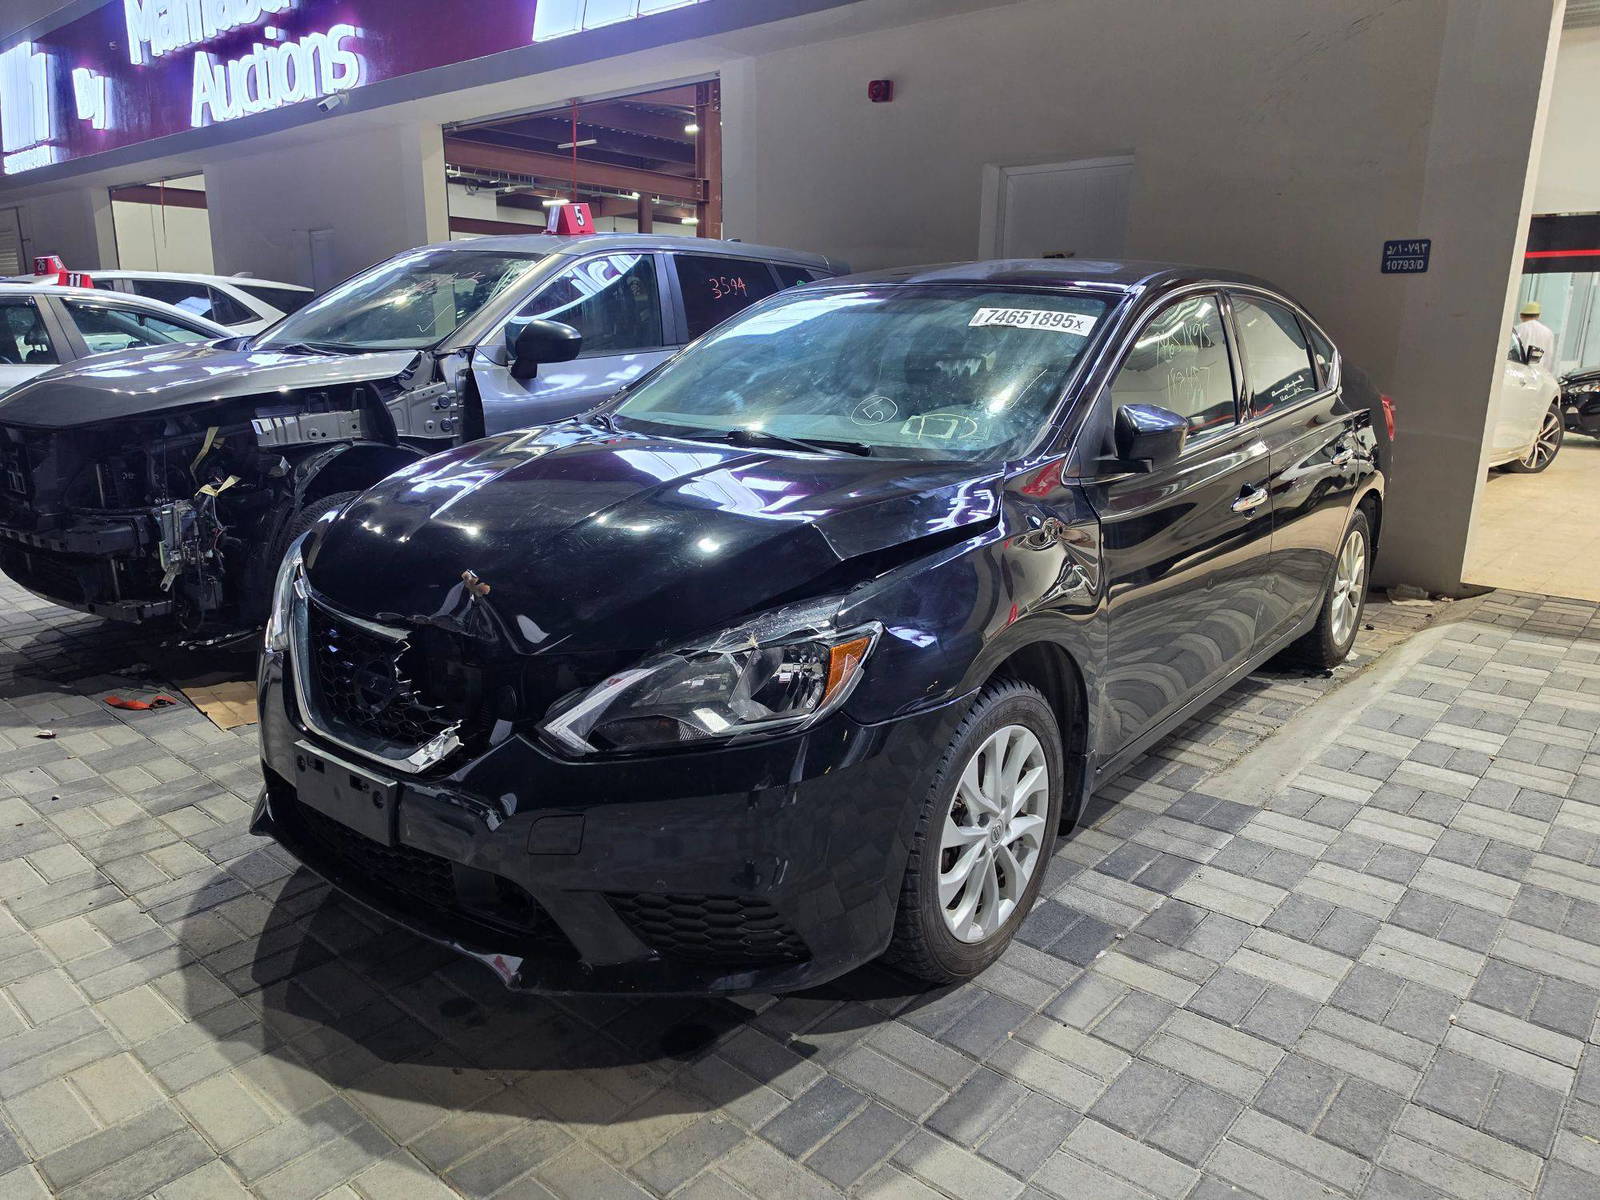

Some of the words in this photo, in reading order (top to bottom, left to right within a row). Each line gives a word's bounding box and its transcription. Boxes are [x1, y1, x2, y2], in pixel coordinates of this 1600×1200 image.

[191, 24, 359, 127] Auctions
[574, 205, 585, 226] 5
[1386, 260, 1424, 270] 10793/D
[69, 273, 81, 287] 11
